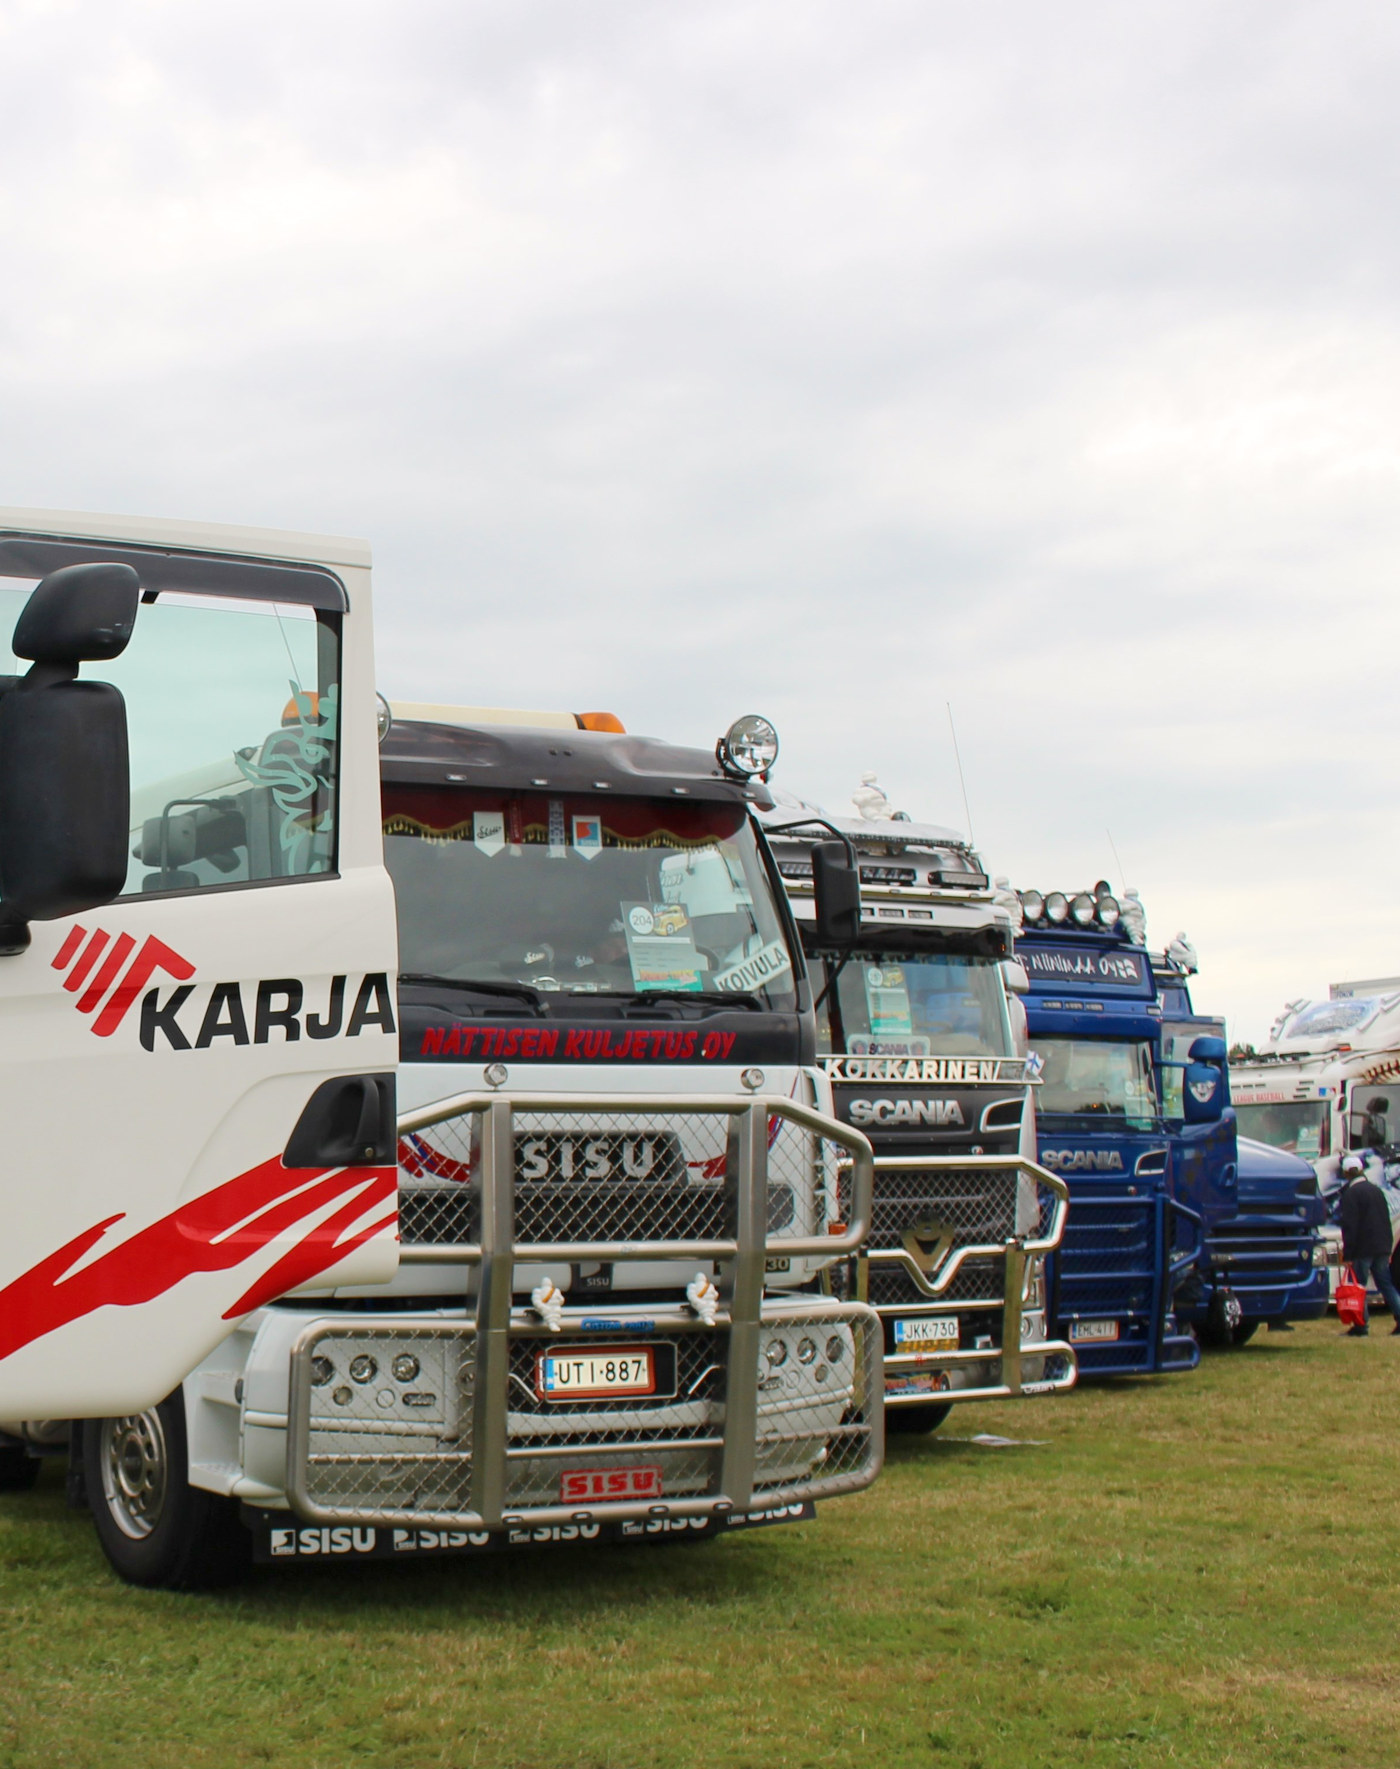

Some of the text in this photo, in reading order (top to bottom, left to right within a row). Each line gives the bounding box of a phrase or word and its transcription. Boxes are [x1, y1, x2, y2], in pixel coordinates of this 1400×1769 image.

[631, 915, 652, 927] 204
[718, 949, 789, 991] KOIVULA
[138, 972, 397, 1053] KARJA
[420, 1022, 737, 1060] NÄTTISEN KULJETUS OY
[824, 1058, 995, 1081] KOKKARINEN
[849, 1099, 965, 1126] SCANIA
[522, 1141, 655, 1179] SISU
[1041, 1149, 1124, 1170] SCANIA
[586, 1277, 610, 1287] SISU
[906, 1320, 956, 1339] JKK-730
[558, 1360, 644, 1385] UTI-887
[566, 1471, 655, 1496] SISU
[299, 1527, 376, 1554] SISU
